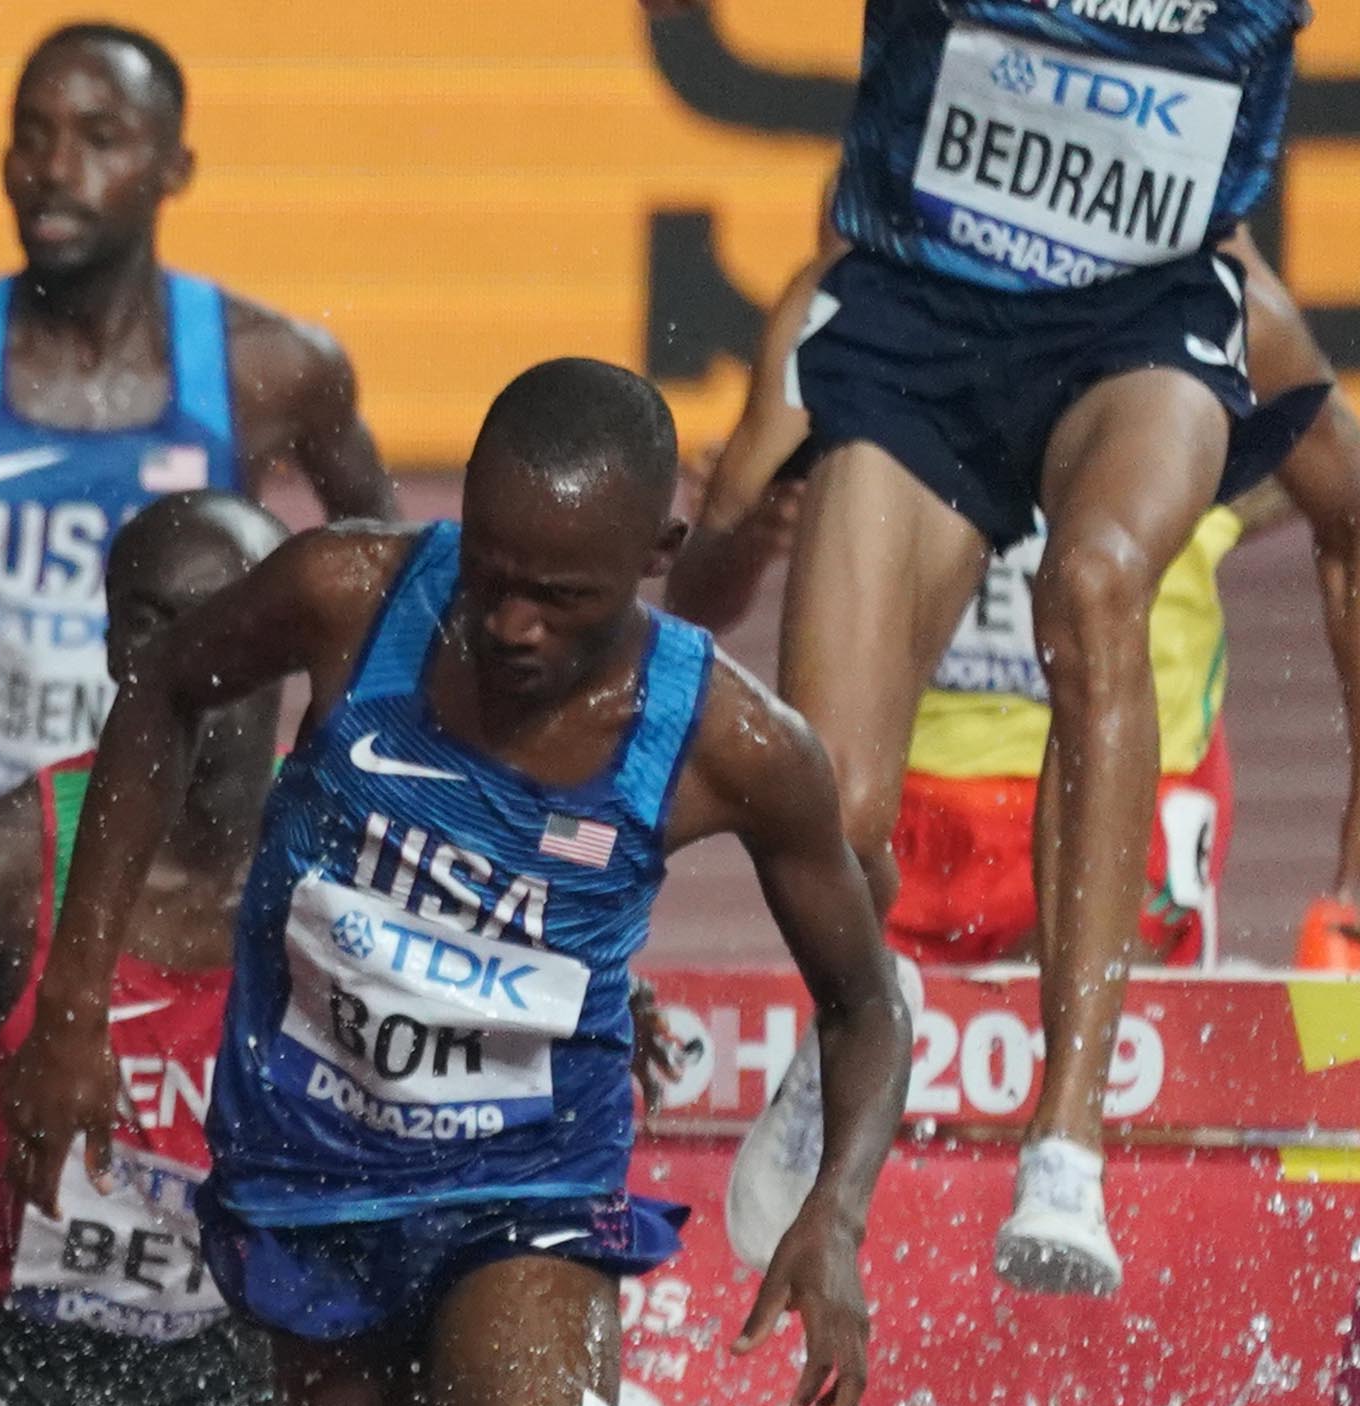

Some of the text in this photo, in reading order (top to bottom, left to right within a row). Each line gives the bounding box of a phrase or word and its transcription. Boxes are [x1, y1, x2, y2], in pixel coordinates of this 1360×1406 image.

[1044, 0, 1217, 34] RANCE
[1043, 57, 1187, 136] TDK
[936, 104, 1195, 249] BEDRANI
[383, 920, 540, 1010] TDK
